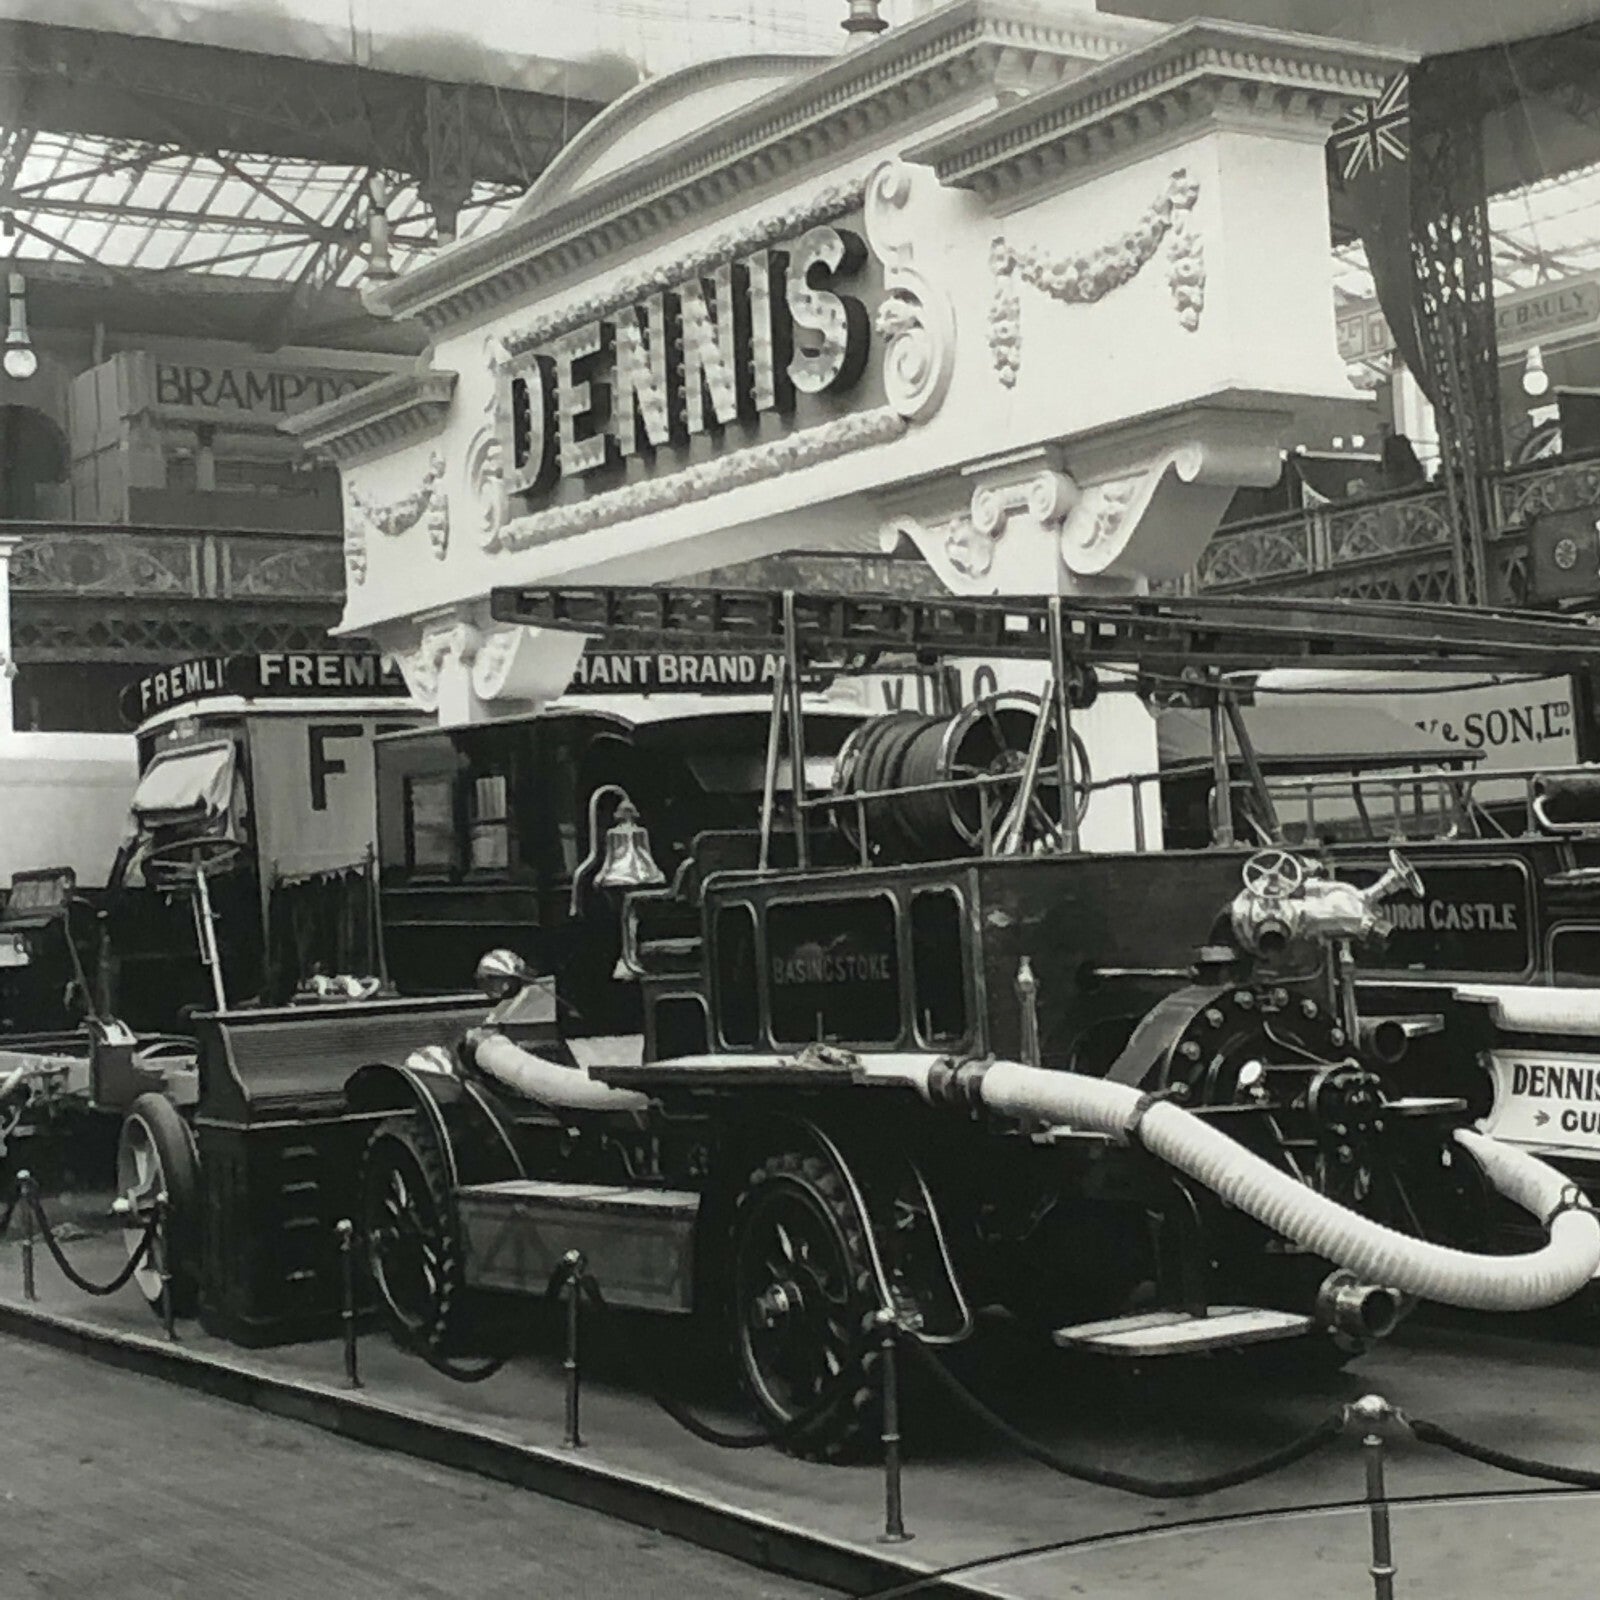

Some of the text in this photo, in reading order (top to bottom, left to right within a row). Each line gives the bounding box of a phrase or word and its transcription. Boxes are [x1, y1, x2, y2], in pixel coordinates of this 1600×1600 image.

[498, 225, 850, 495] DENNIS
[658, 653, 756, 684] BRAND
[1429, 900, 1517, 932] CASTLE
[772, 954, 890, 985] BASINGSTOKE
